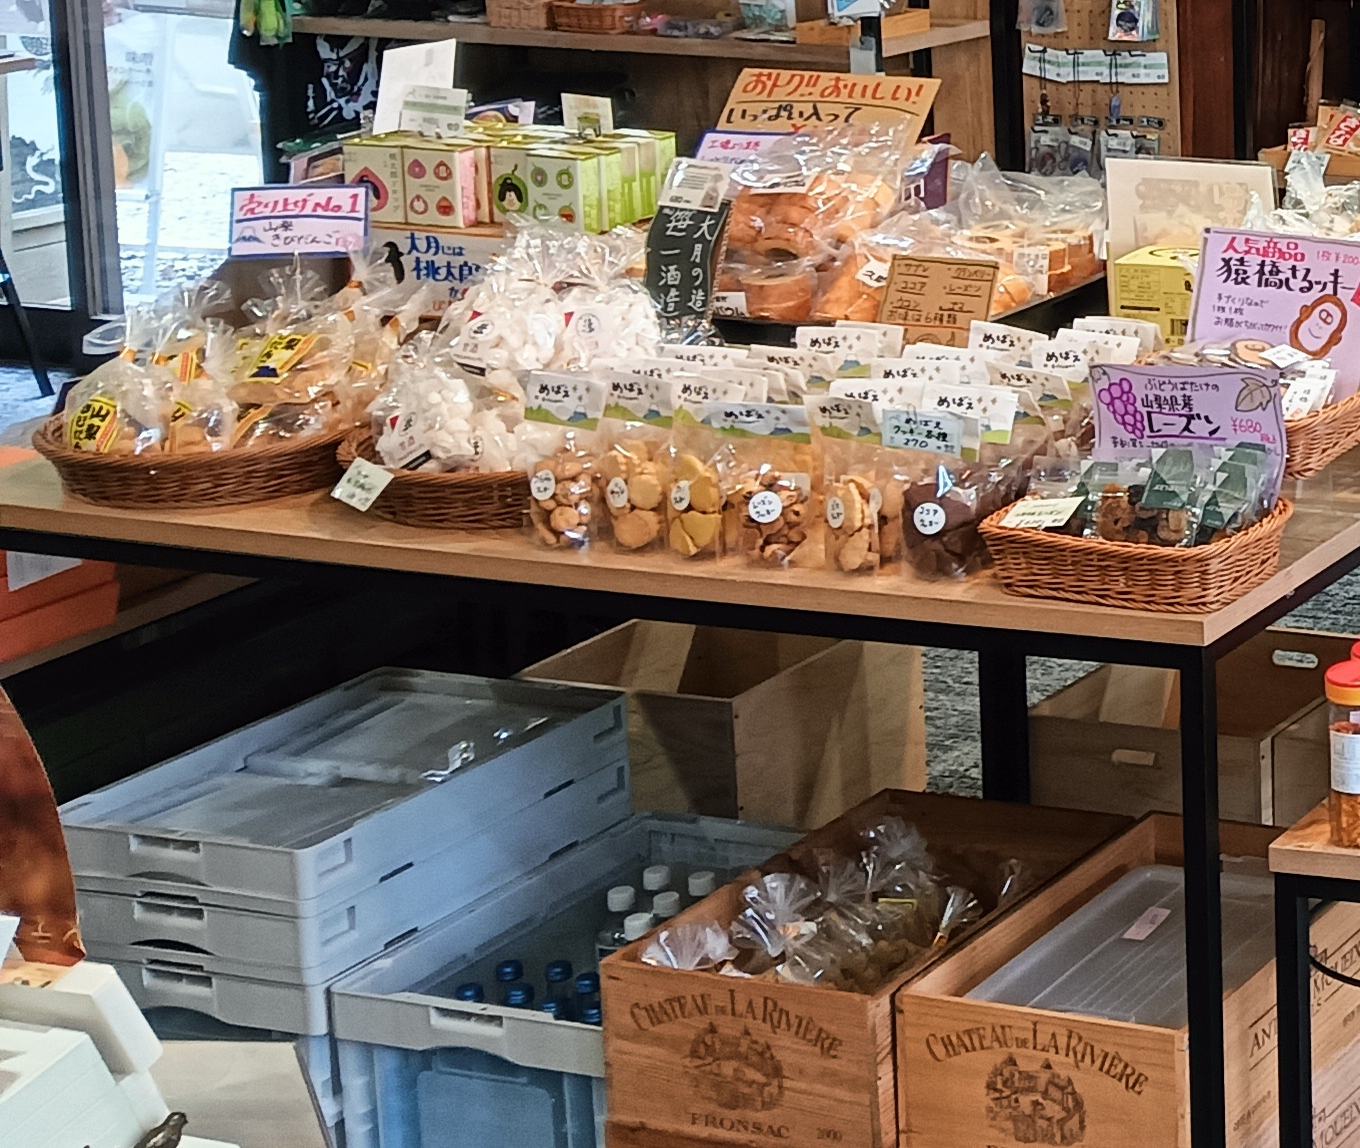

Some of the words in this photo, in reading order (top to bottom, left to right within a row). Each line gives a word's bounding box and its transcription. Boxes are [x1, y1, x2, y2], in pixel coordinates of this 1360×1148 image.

[1222, 236, 1306, 263] 人気商品
[1215, 255, 1356, 297] 猿橋さるッキー
[1146, 411, 1221, 437] レーズン
[1230, 416, 1263, 435] ¥680
[629, 993, 712, 1032] CHATEAU
[728, 988, 757, 1021] LA
[925, 1024, 1017, 1064] CHATEAU
[1030, 1020, 1061, 1055] LA
[1064, 1027, 1150, 1096] RIVIÈRE
[690, 1112, 791, 1139] FRONSAC
